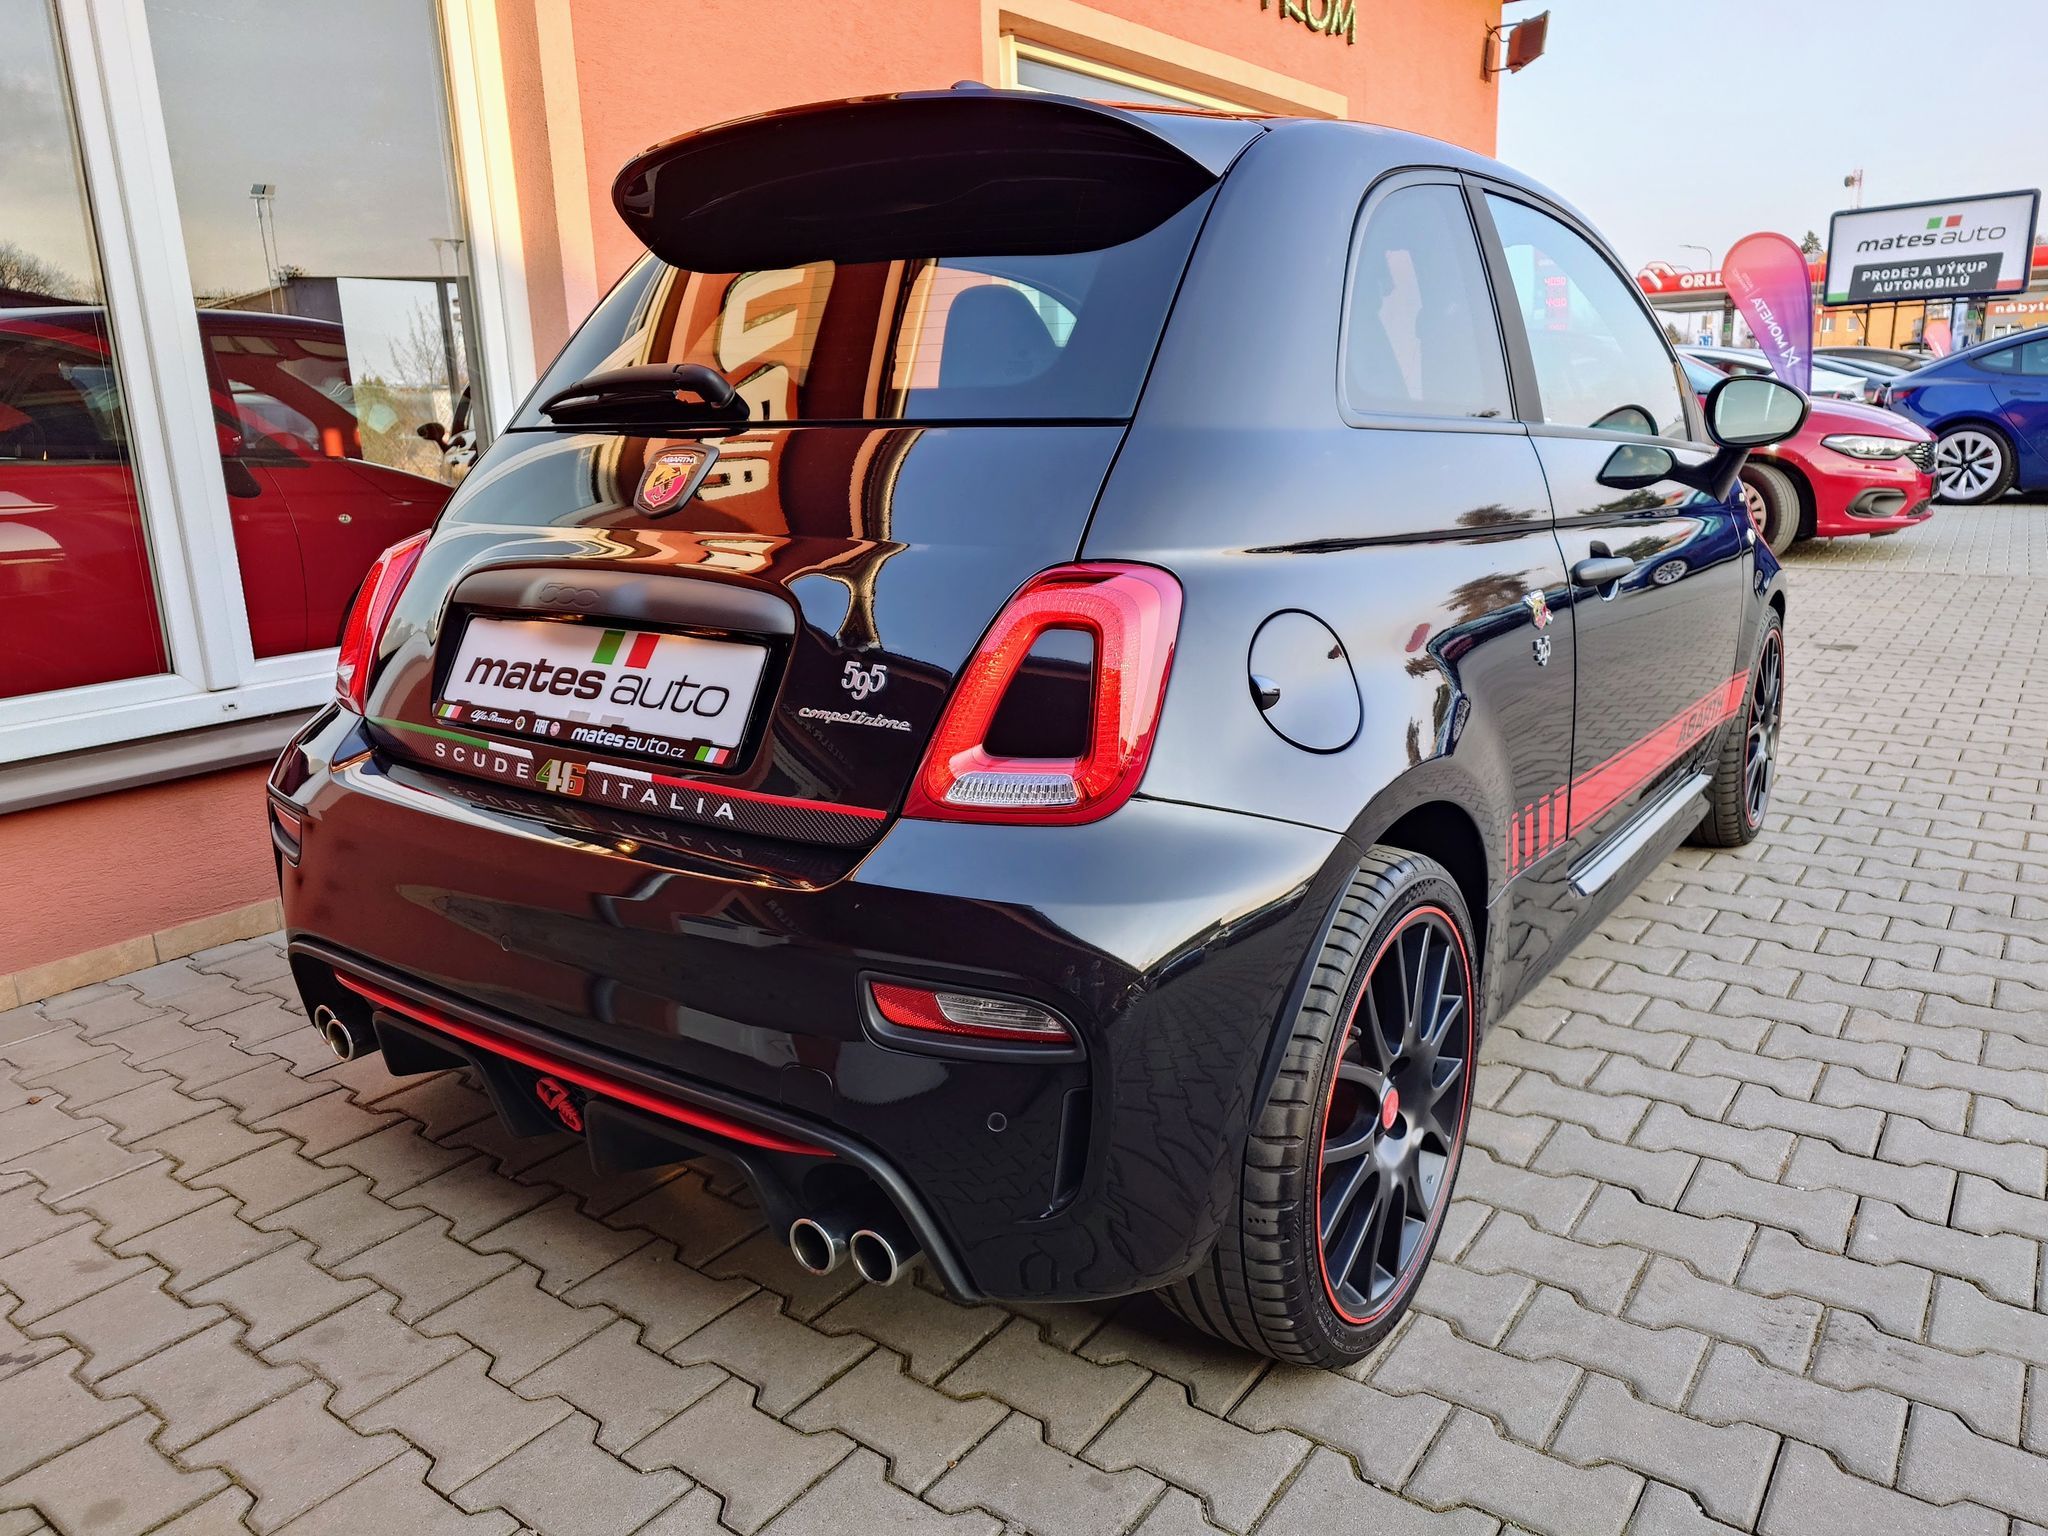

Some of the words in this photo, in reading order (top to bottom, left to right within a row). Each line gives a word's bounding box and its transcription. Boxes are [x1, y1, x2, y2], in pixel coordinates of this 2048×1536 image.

[1857, 233, 1937, 252] mates
[1940, 226, 2006, 244] auto
[1861, 265, 1919, 281] PRODEJ
[1921, 267, 1932, 278] A
[1936, 260, 1988, 274] VÝKUP
[1873, 274, 1970, 293] AUTOMOBILŮ
[465, 656, 606, 700] mates
[610, 674, 730, 718] auto
[841, 660, 887, 700] 595
[533, 719, 549, 735] FIAT
[799, 707, 912, 731] competizione
[435, 742, 530, 778] SCUDE
[536, 759, 587, 797] 46
[602, 779, 735, 821] ITALIA
